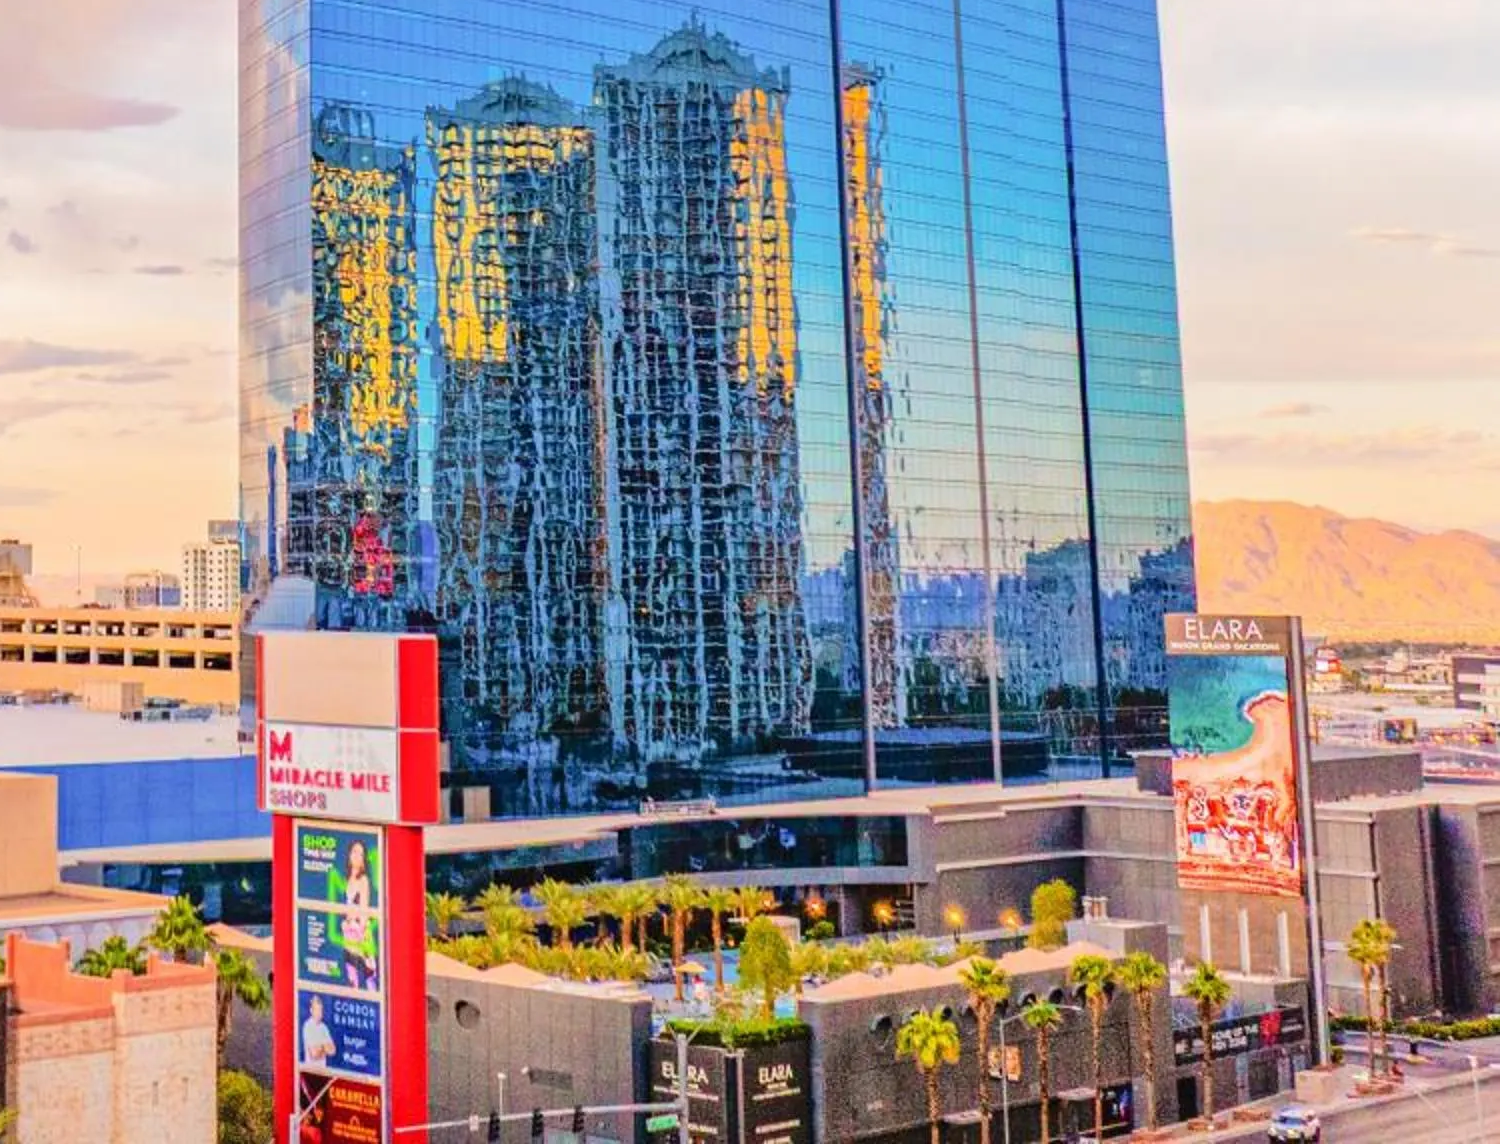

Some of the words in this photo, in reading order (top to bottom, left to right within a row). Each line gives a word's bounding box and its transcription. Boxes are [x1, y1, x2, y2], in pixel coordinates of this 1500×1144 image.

[1184, 618, 1263, 641] ELARA
[270, 766, 343, 789] MIRACLE
[350, 771, 391, 792] MILE
[269, 789, 328, 809] SHOPS
[303, 834, 337, 850] SHOP
[661, 1061, 709, 1084] ELRA
[758, 1063, 793, 1084] ELARA
